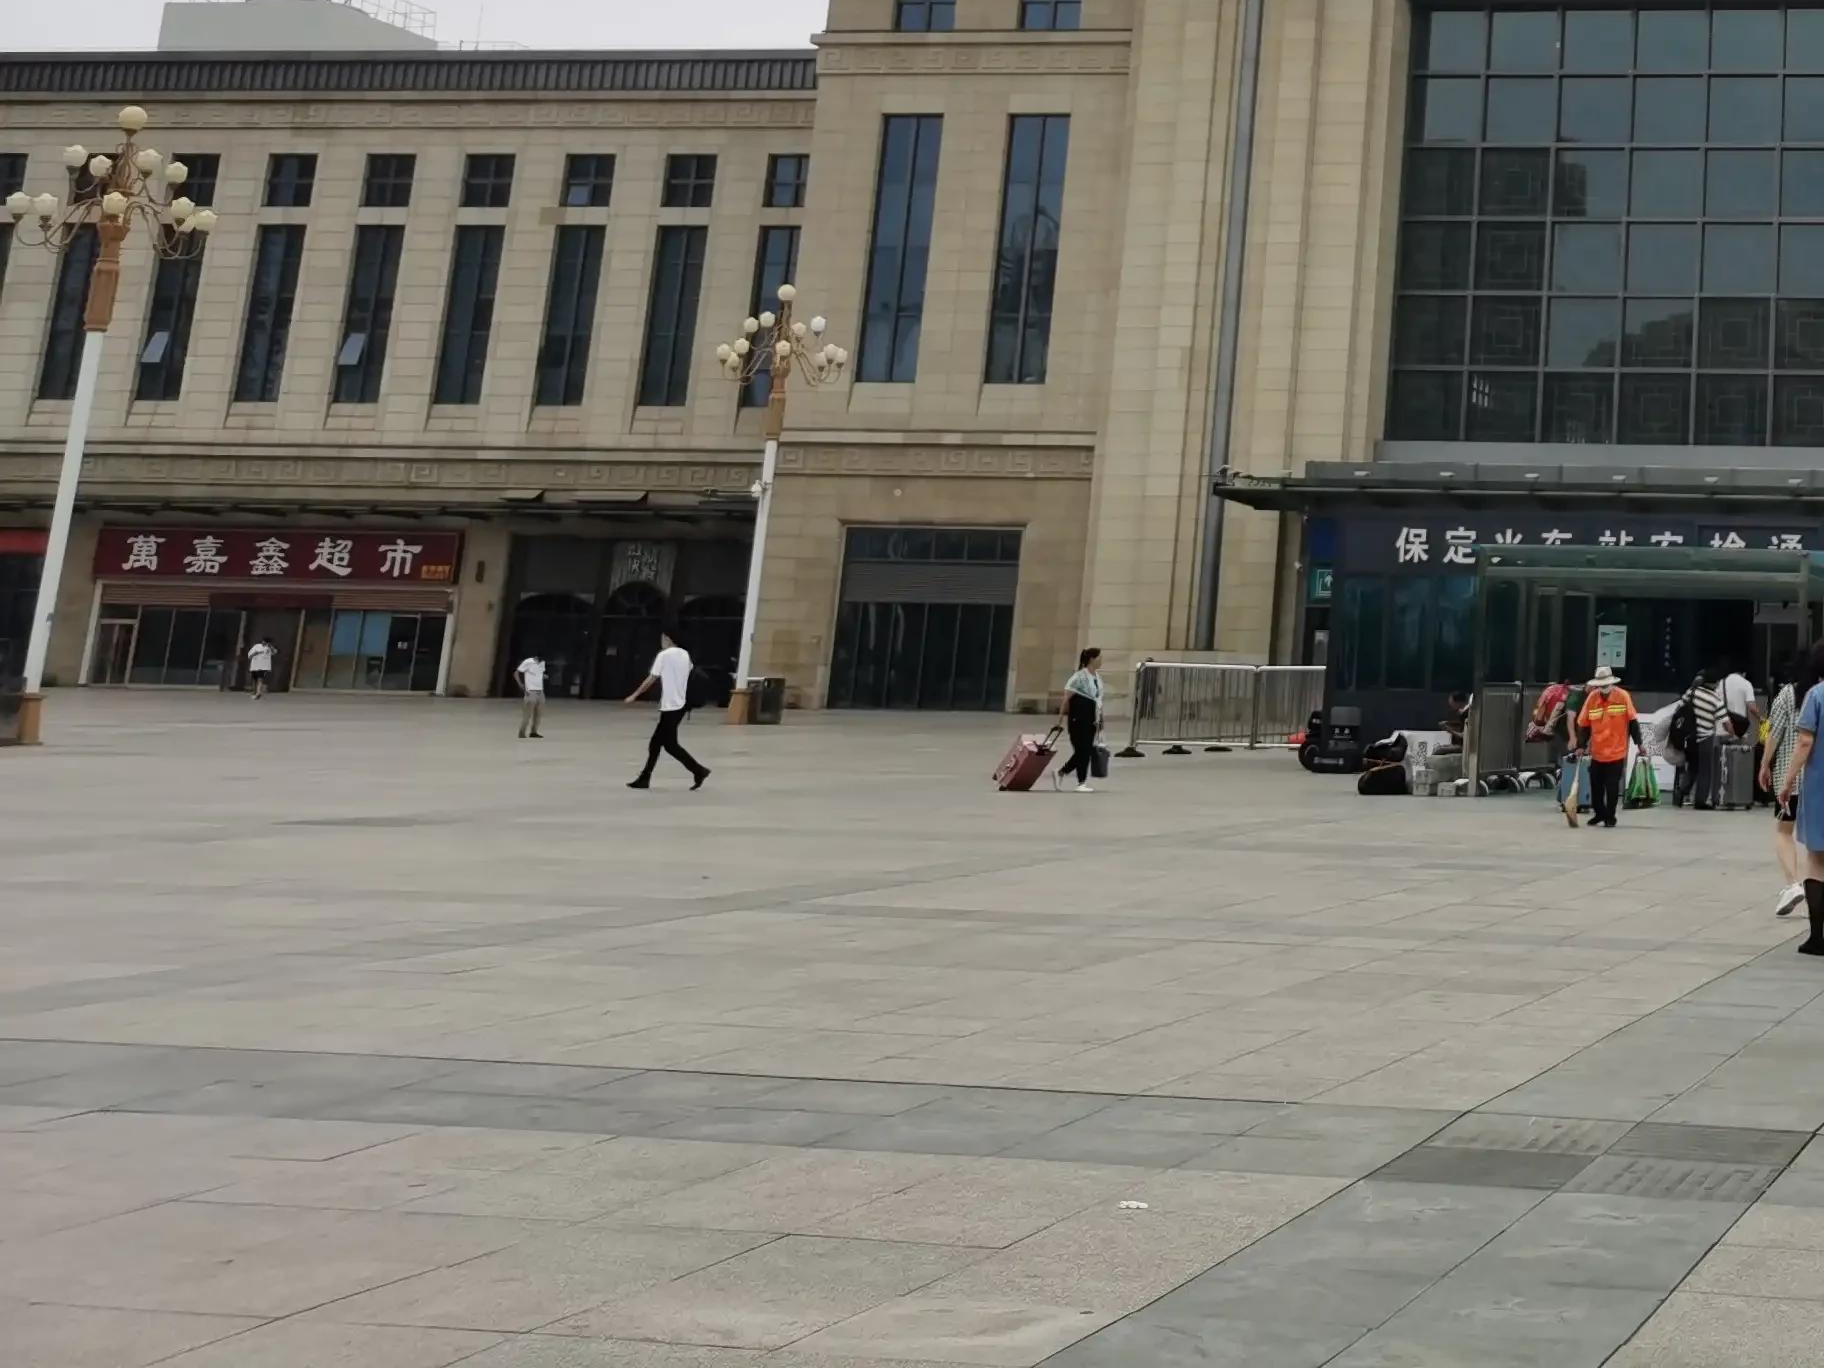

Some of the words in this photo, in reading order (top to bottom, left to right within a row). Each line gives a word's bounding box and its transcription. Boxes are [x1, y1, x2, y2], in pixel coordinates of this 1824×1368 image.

[122, 534, 423, 577] 萬嘉鑫超市
